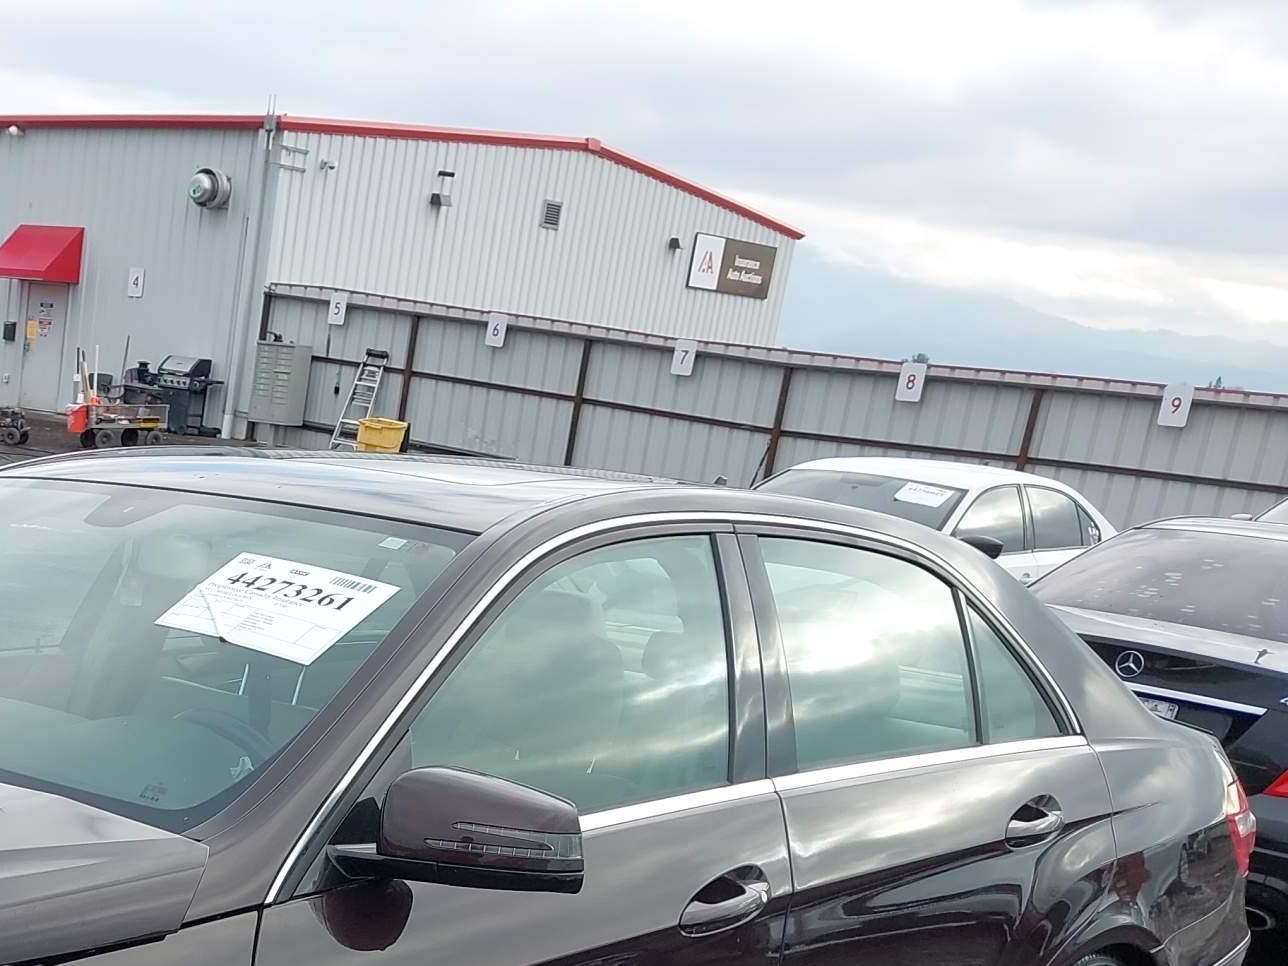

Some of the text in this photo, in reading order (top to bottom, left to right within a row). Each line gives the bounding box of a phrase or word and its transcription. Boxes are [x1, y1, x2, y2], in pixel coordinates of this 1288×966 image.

[132, 275, 139, 288] 4
[333, 301, 341, 315] 5
[492, 322, 500, 336] 6
[680, 349, 689, 365] 7
[905, 374, 917, 390] 8
[1171, 396, 1182, 414] 9
[226, 571, 356, 612] 44273261
